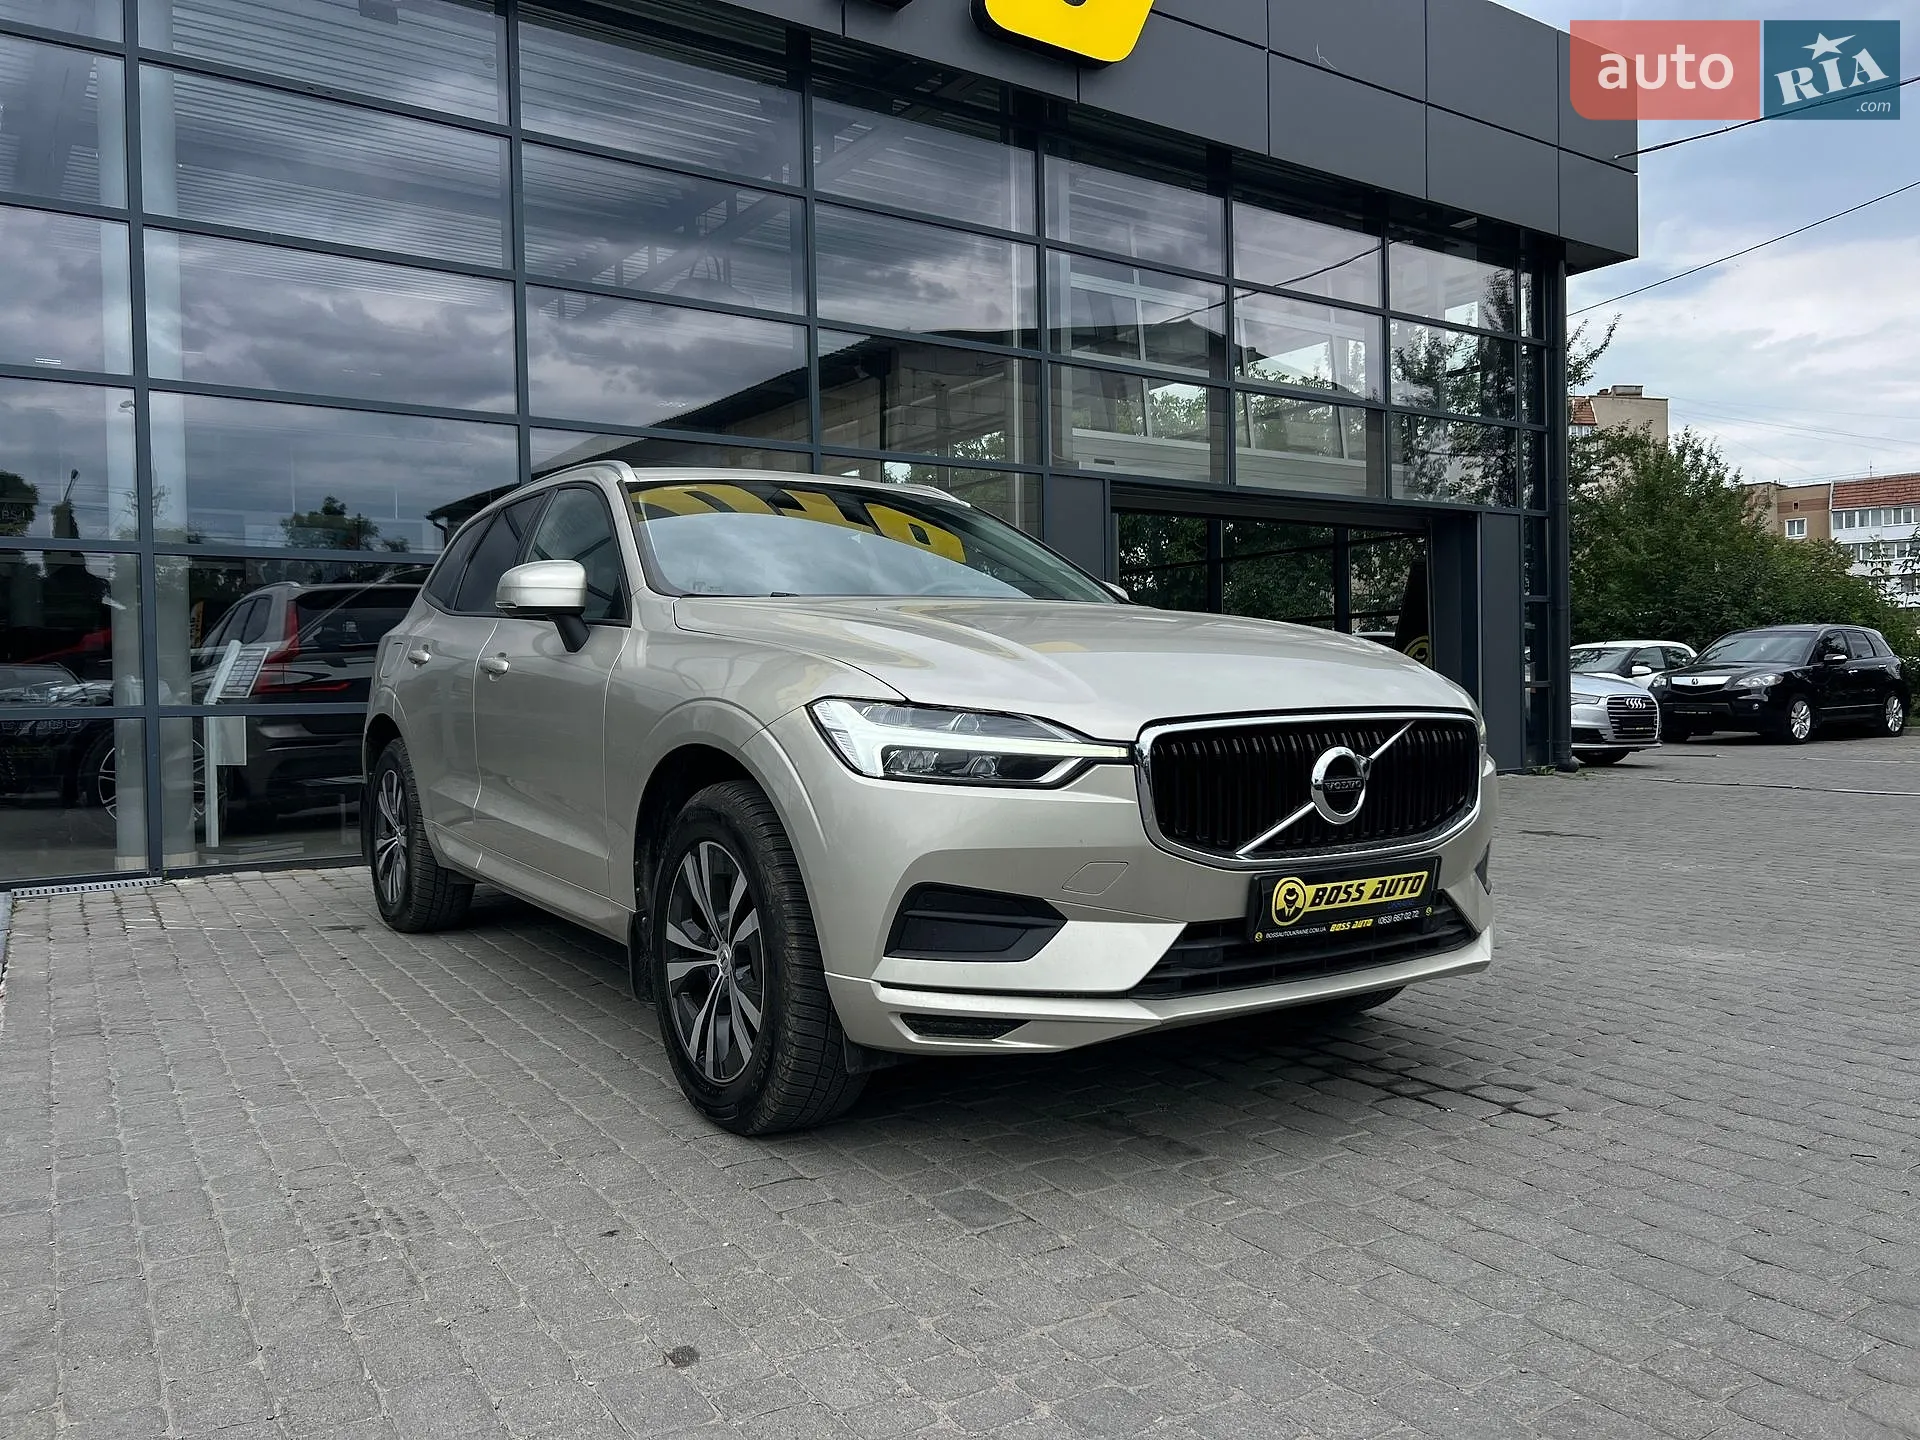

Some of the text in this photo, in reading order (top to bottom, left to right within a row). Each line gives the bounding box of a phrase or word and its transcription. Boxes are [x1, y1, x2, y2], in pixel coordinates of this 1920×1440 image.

[1324, 780, 1362, 790] VOLVO
[1308, 875, 1425, 908] BOSS AUTO
[1329, 919, 1374, 932] BOSS AUTO
